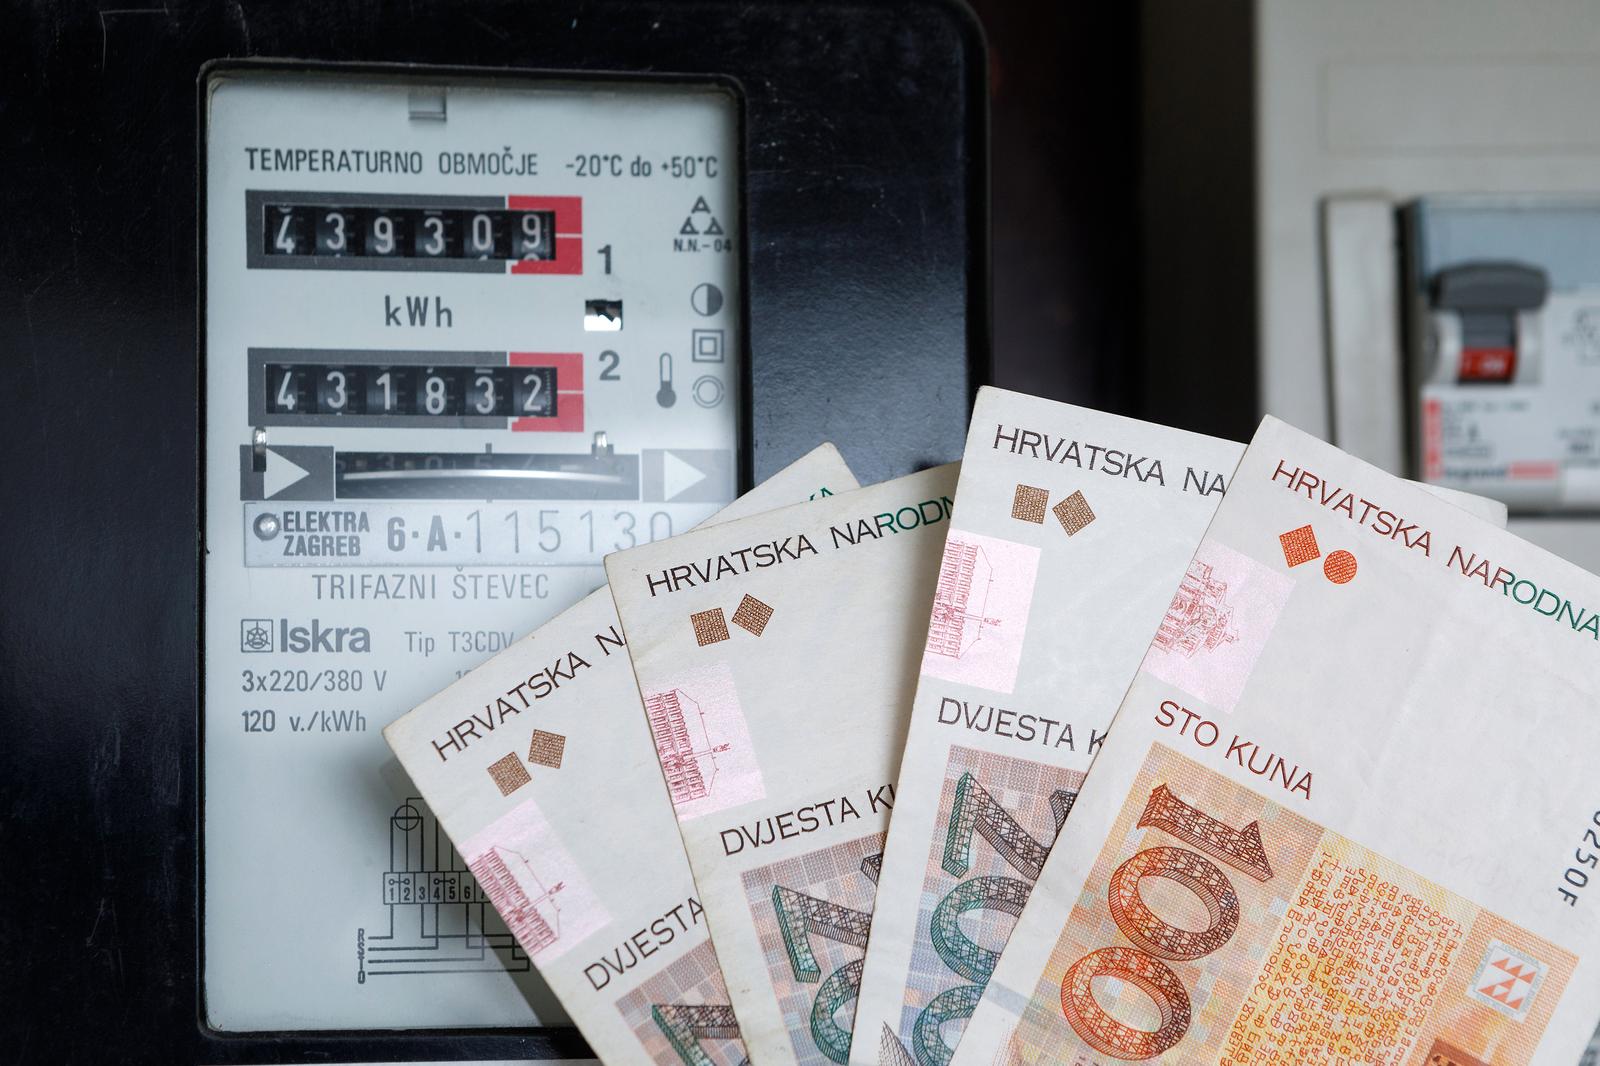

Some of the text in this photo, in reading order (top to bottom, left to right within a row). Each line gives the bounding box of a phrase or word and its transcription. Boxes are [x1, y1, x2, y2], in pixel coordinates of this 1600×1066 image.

[245, 147, 423, 174] TEMPERATURNO
[438, 146, 538, 176] OBMOČJE
[630, 155, 652, 177] do
[597, 244, 612, 275] 1
[385, 295, 453, 328] kWh
[599, 350, 621, 381] 2
[993, 424, 1166, 487] HRVATSKA
[283, 511, 370, 532] ELEKTRA
[283, 535, 361, 557] ZAGREB
[646, 534, 818, 597] HRVATSKA
[1271, 460, 1599, 640] HRVATSKA NARODNA
[312, 565, 549, 600] TRIFAZNI ŠTEVEC
[280, 618, 514, 657] Iskra Tip T3CDV
[242, 669, 387, 692] 3x220/380 V
[241, 709, 367, 732] 120 v./kWh
[431, 651, 592, 762] HRVATSKA
[938, 697, 1076, 752] DVJESTA
[1154, 700, 1314, 800] STO KUNA
[719, 796, 861, 857] DVJESTA
[1060, 783, 1275, 1061] 100
[583, 897, 704, 992] DVJESTA
